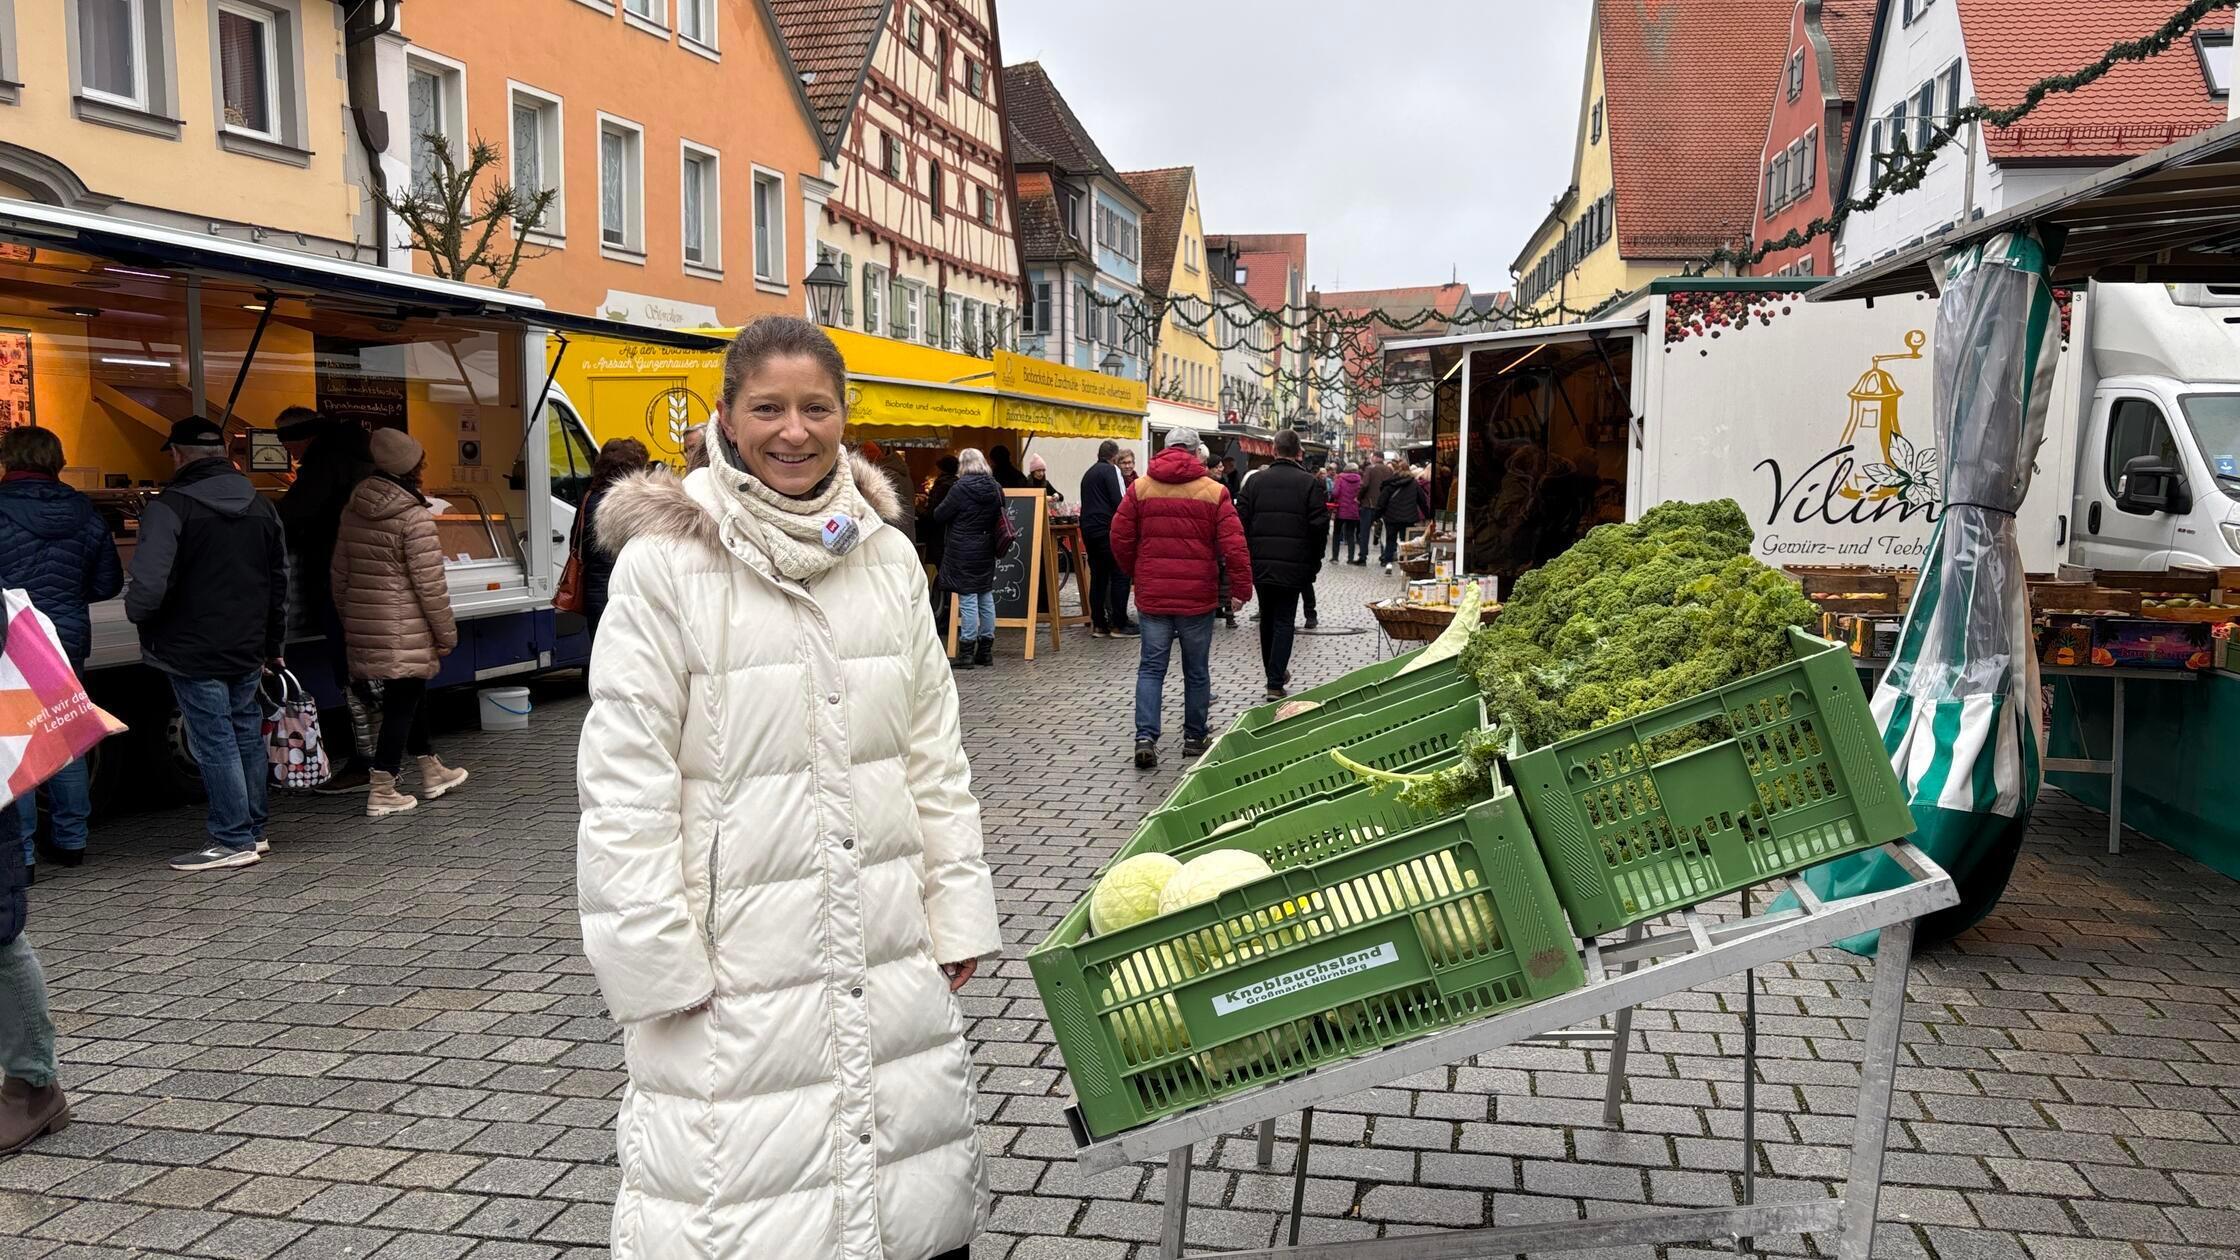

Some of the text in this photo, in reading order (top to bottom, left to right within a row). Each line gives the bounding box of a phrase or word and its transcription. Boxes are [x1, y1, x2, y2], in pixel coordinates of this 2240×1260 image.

[582, 360, 591, 369] in
[635, 357, 700, 373] Gunzenhausen
[701, 358, 719, 369] und
[884, 399, 914, 409] Biobrote
[915, 403, 929, 411] und
[1762, 534, 1835, 556] Gewürz-
[1838, 537, 1873, 555] und
[26, 690, 88, 729] weil wir das
[43, 701, 93, 733] Leben lie
[1225, 946, 1383, 1003] Knoblauchsland
[1246, 963, 1368, 1005] Großmarkt Nürnberg
